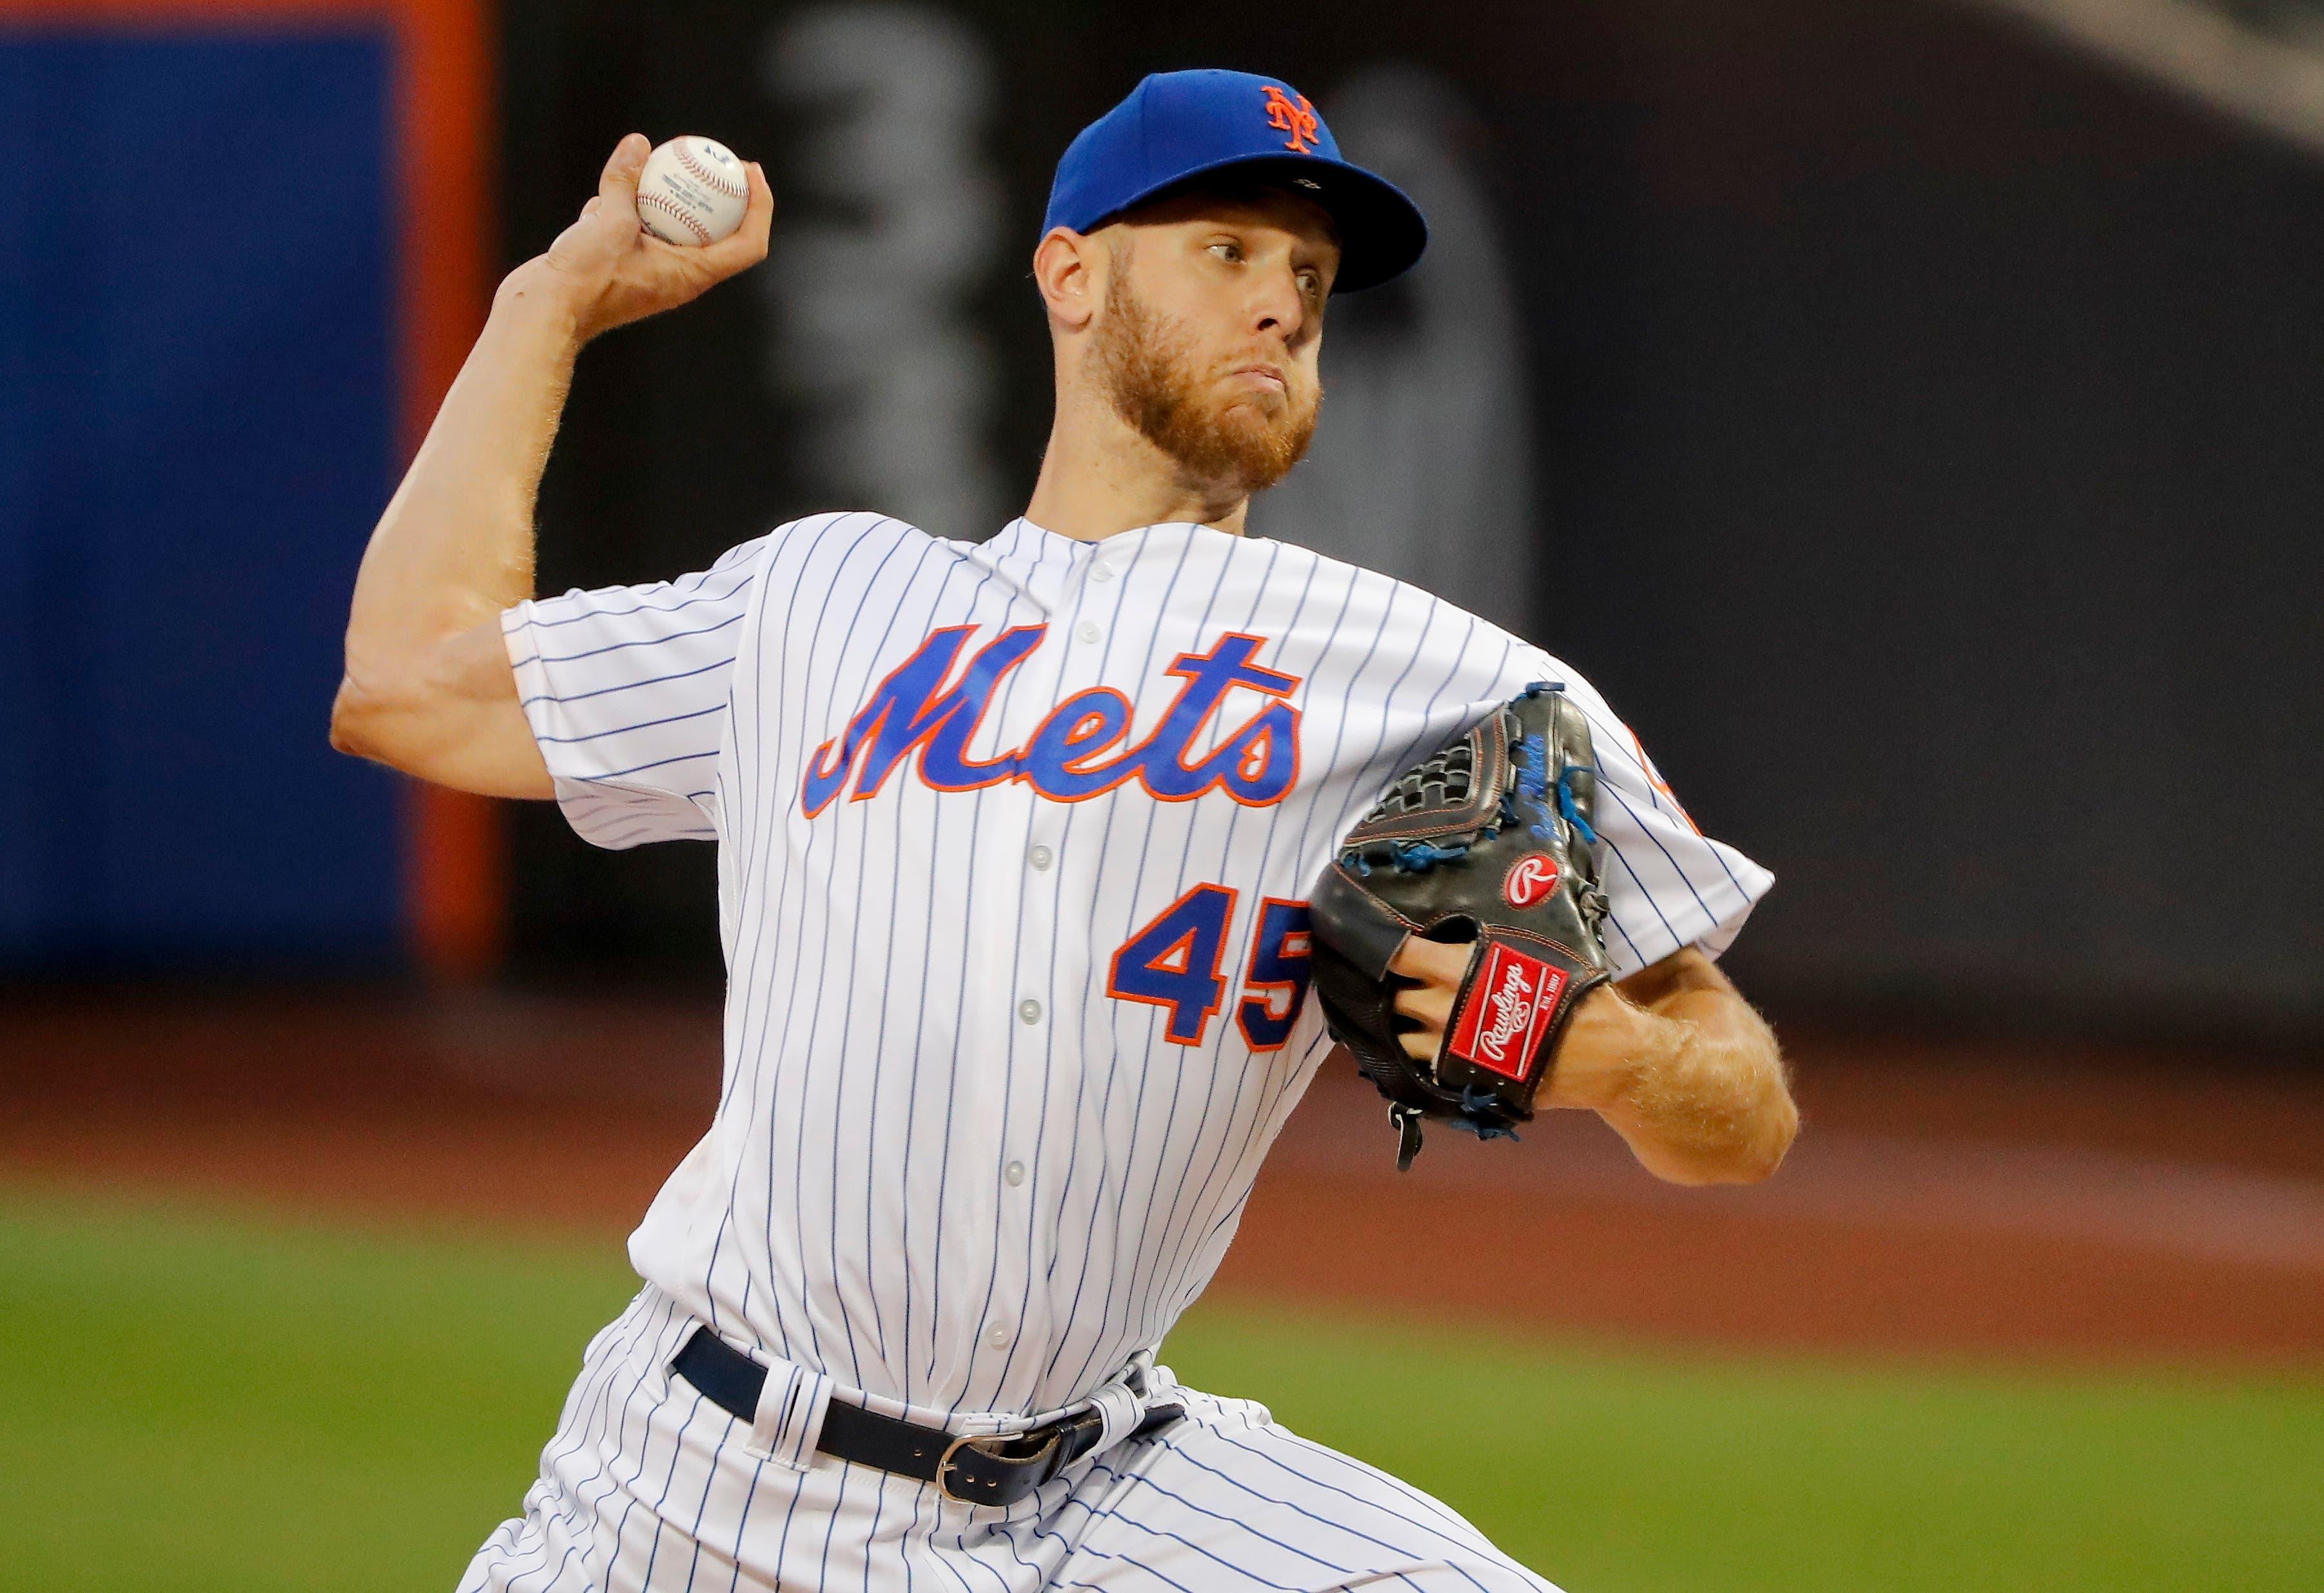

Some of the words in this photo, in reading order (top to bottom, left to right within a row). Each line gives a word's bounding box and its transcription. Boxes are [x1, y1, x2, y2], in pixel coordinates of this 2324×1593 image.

[1261, 85, 1319, 154] NY
[801, 623, 1303, 819] Mets
[1106, 882, 1312, 1053] 45
[1481, 963, 1532, 1061] Rawlings
